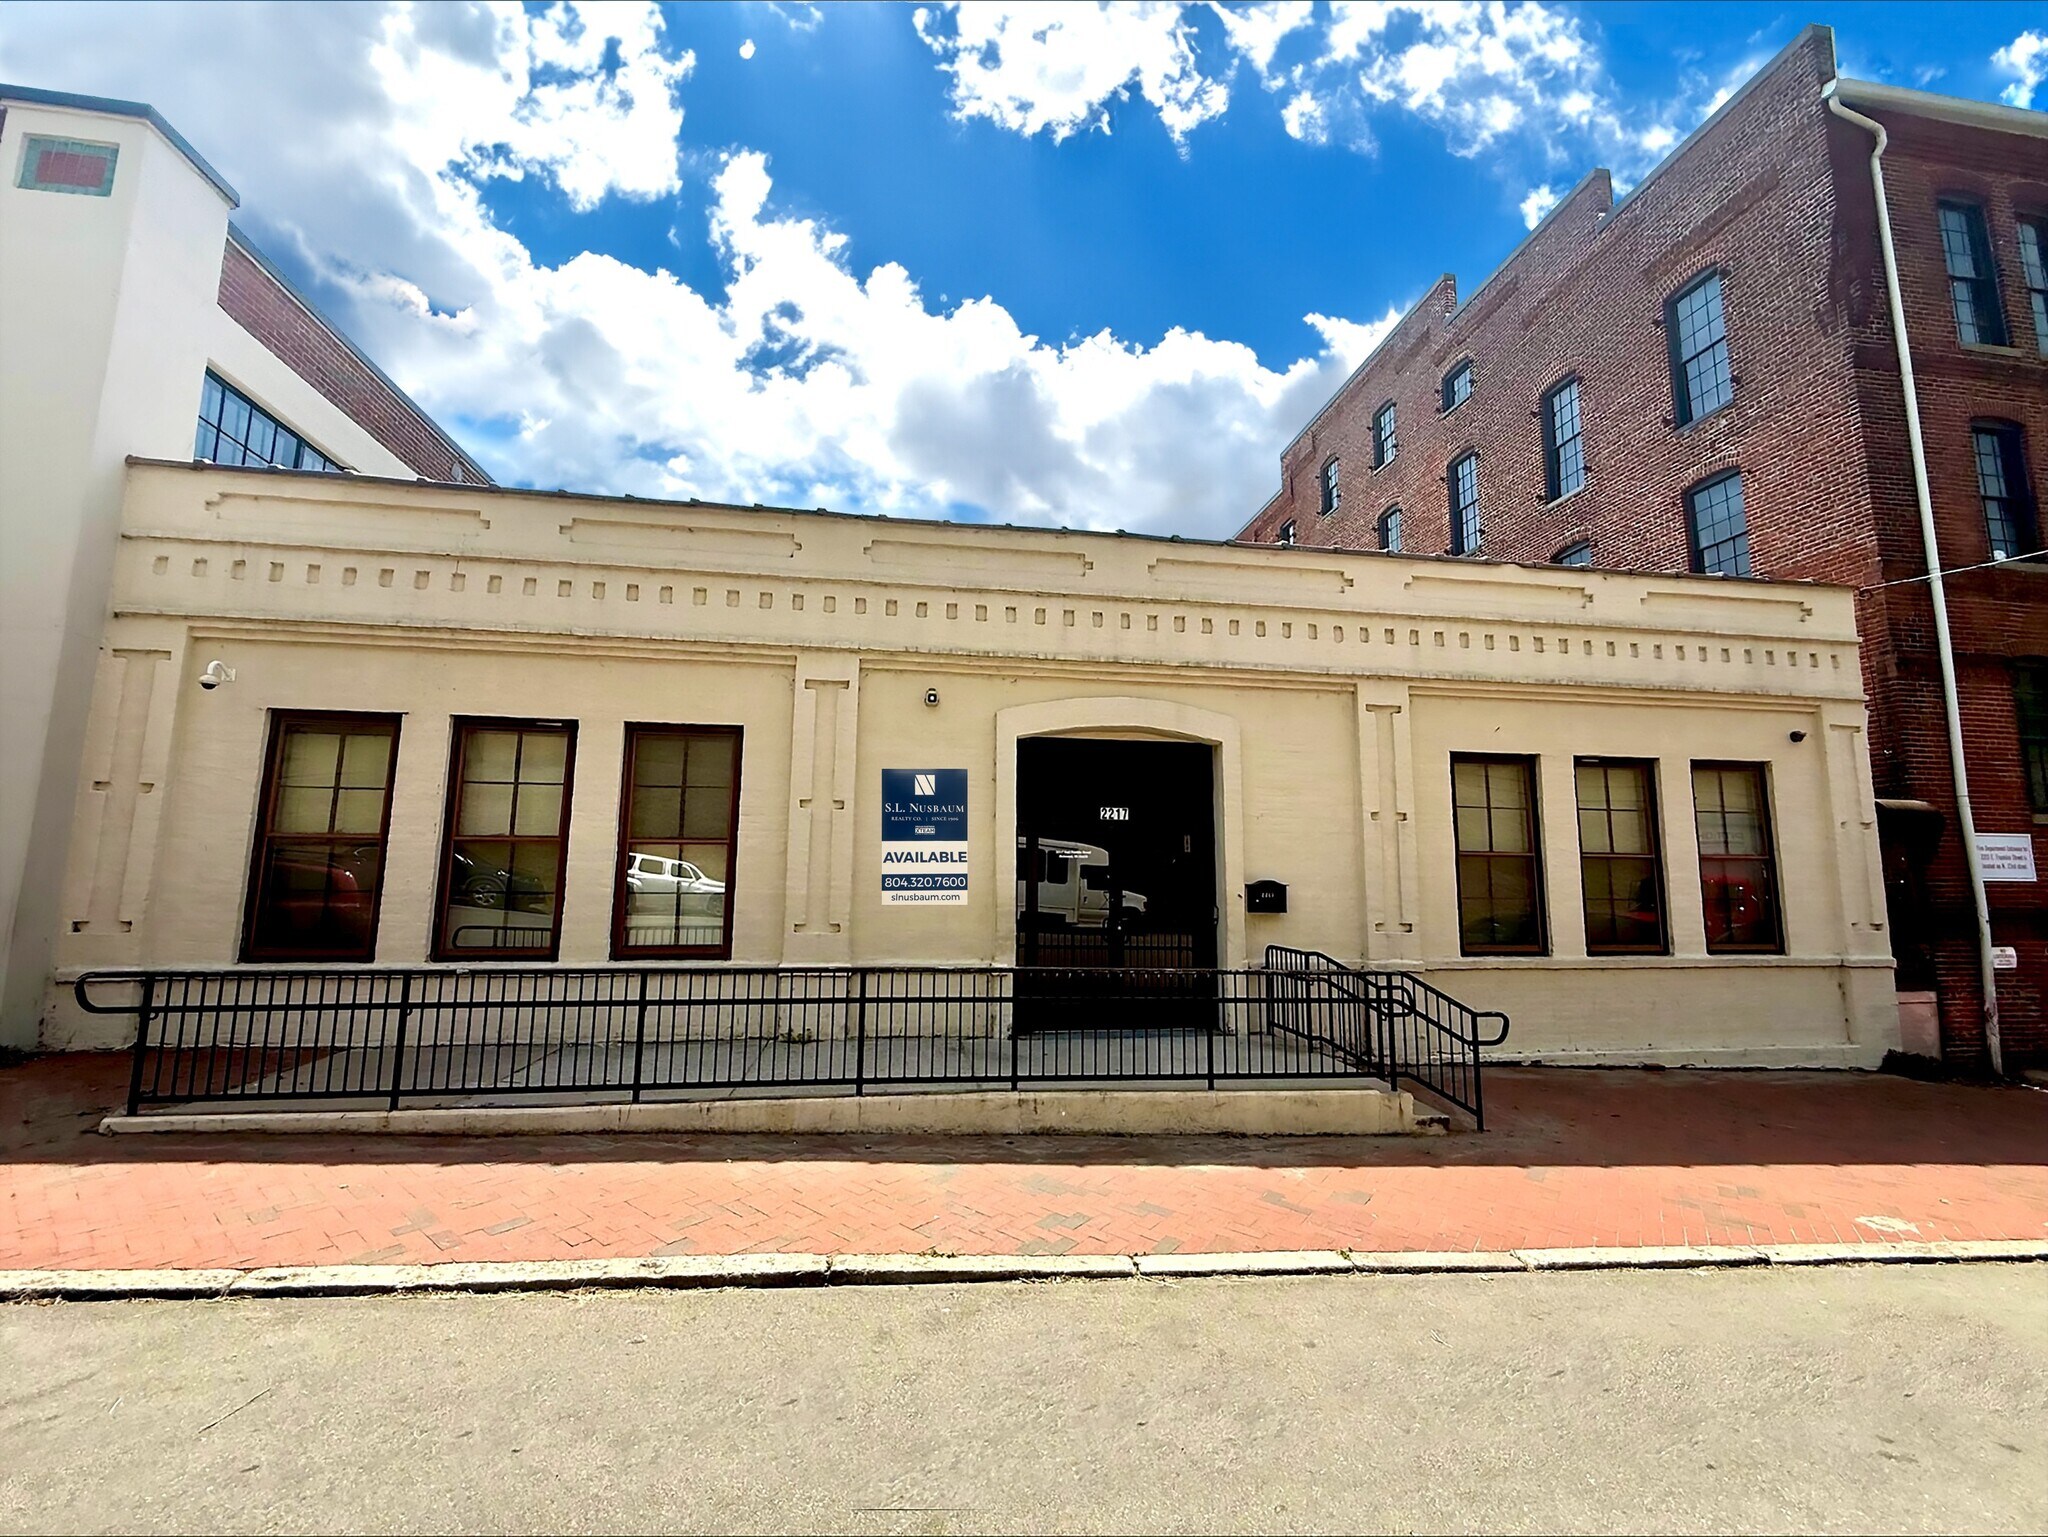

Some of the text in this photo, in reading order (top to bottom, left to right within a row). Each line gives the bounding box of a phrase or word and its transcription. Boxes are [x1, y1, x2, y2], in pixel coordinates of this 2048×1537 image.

[885, 803, 964, 813] S.L. NUSBAUM
[1101, 807, 1128, 820] 2217
[883, 852, 968, 863] AVAILABLE
[884, 877, 966, 888] 804.320.7600
[891, 893, 960, 901] slnusbaum.com
